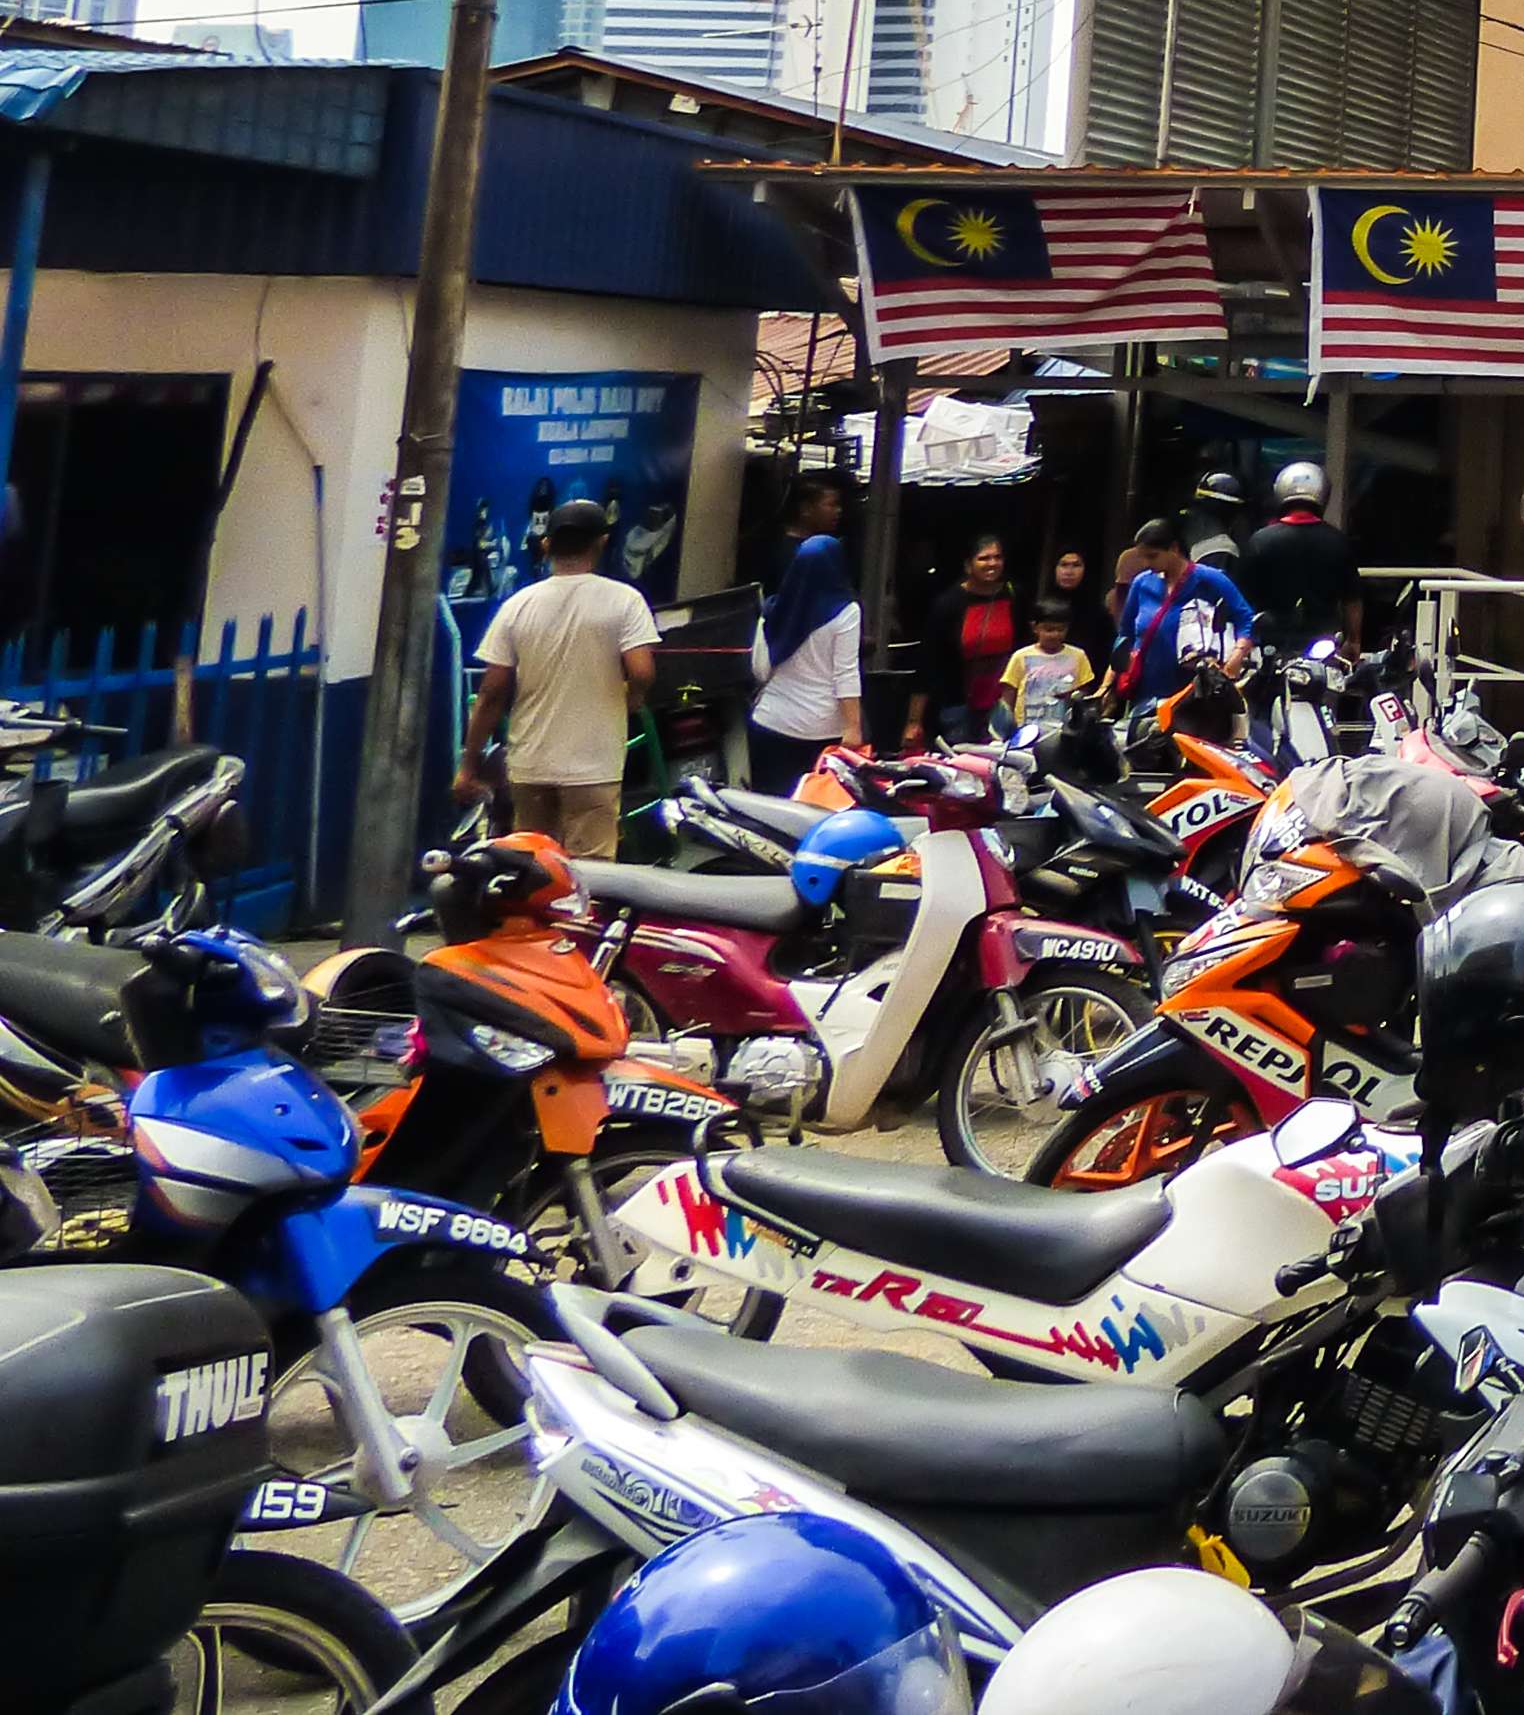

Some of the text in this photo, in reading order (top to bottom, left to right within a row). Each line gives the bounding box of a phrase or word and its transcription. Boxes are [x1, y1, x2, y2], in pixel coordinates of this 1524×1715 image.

[378, 1201, 447, 1235] WSF
[157, 1352, 268, 1442] THULE
[1234, 1508, 1308, 1522] SUZUKI
